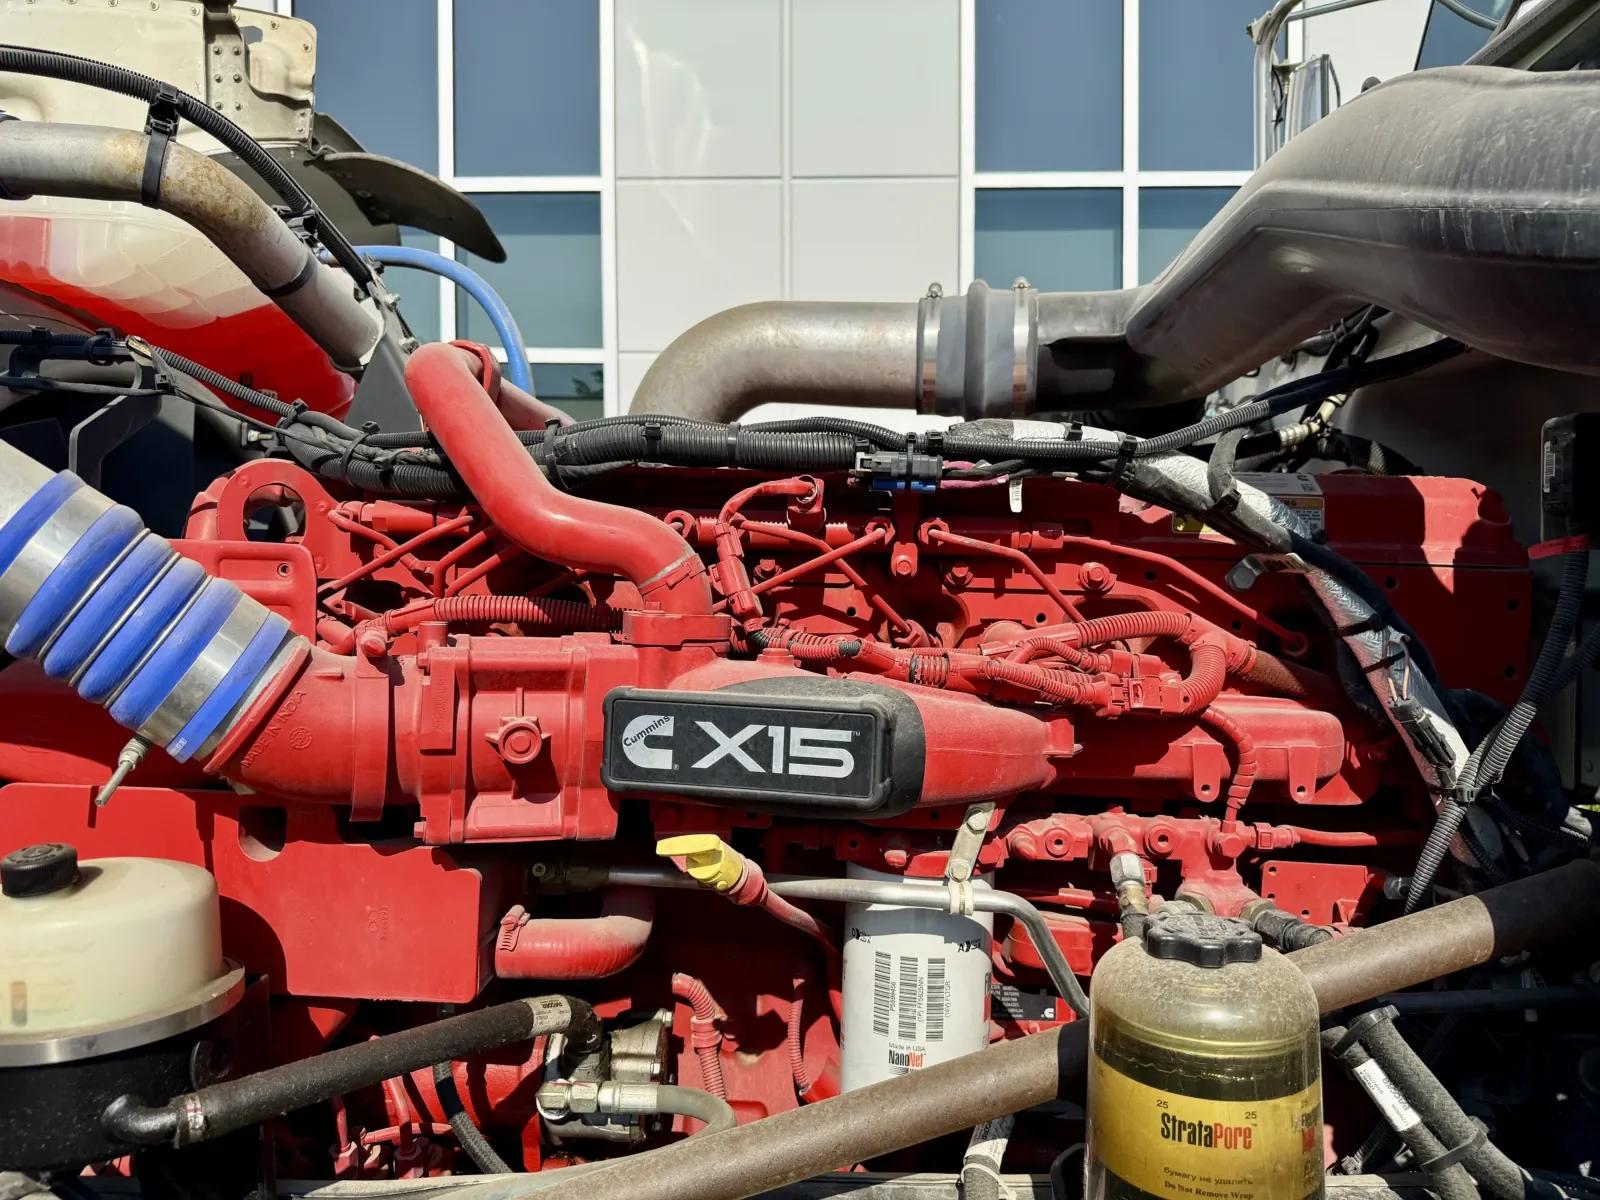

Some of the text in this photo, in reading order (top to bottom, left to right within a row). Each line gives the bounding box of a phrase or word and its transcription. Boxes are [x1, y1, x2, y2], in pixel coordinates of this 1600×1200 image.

[241, 737, 270, 768] MADE
[278, 692, 306, 723] INDIA
[623, 715, 670, 747] Cummins
[691, 720, 855, 779] X15
[888, 1042, 905, 1050] Made
[888, 1049, 924, 1068] NanoNet
[1156, 1099, 1169, 1109] 25
[1244, 1111, 1257, 1120] 25
[1160, 1112, 1253, 1150] StrataPore
[1164, 1180, 1176, 1190] Do
[1177, 1184, 1193, 1194] Not
[1195, 1187, 1229, 1199] Remove
